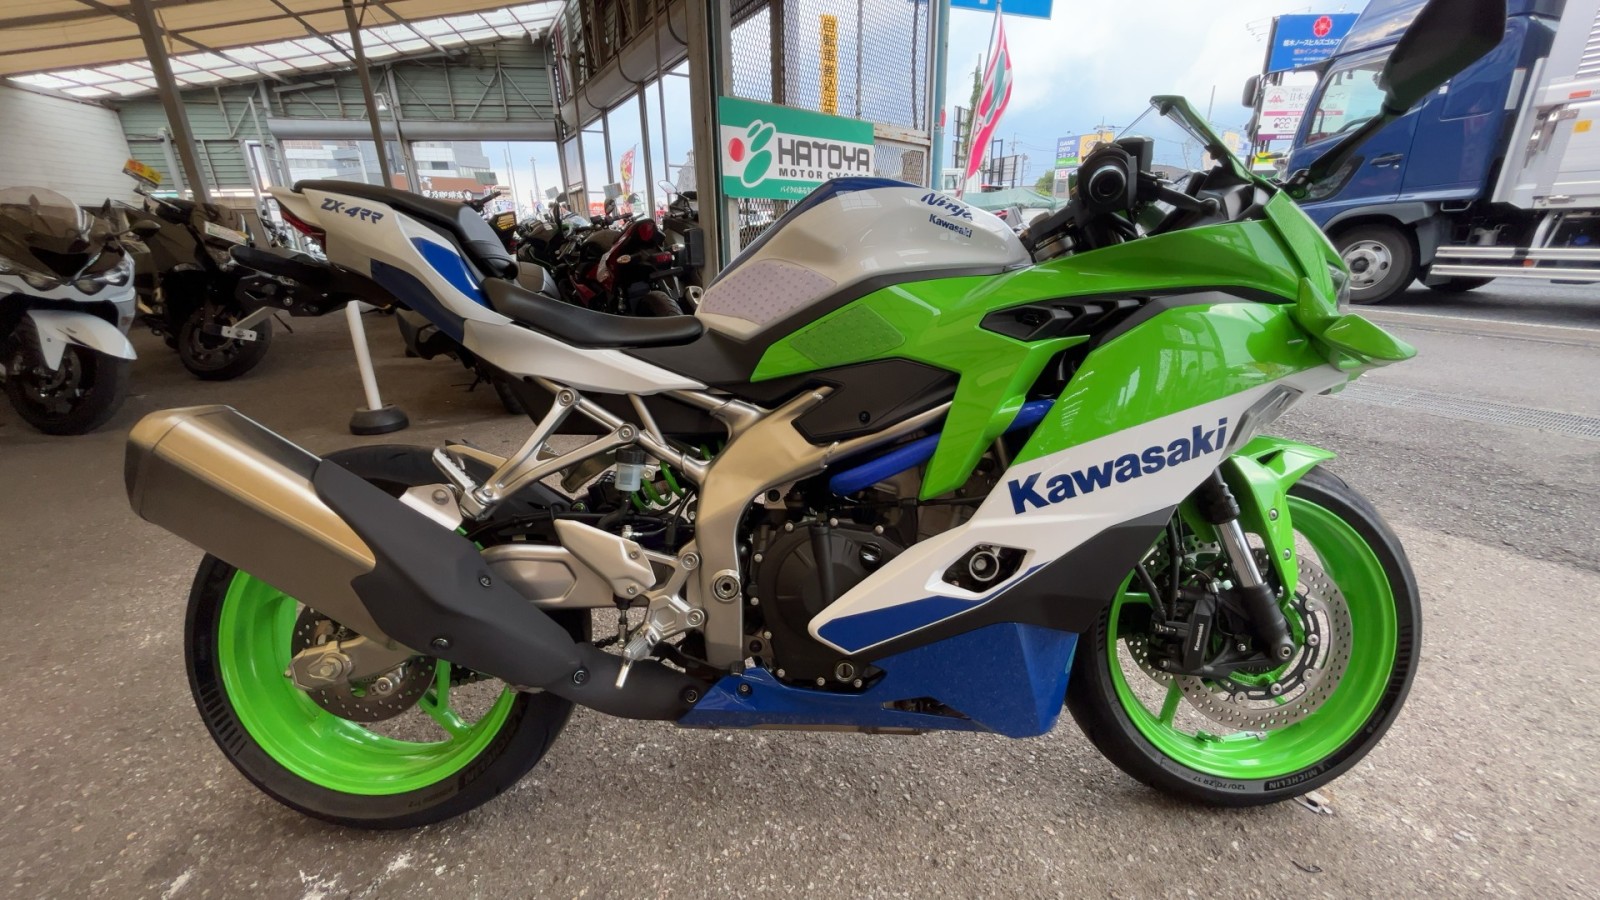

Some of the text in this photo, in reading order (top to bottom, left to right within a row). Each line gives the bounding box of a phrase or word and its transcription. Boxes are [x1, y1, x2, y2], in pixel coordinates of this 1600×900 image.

[777, 137, 870, 172] HATOYA
[778, 167, 823, 180] MOTOR
[321, 198, 384, 224] ZX-4RR
[920, 192, 973, 221] Ninja
[929, 214, 973, 238] Kawasaki
[1007, 417, 1228, 515] Kawasaki
[1268, 770, 1318, 790] MICHELIN
